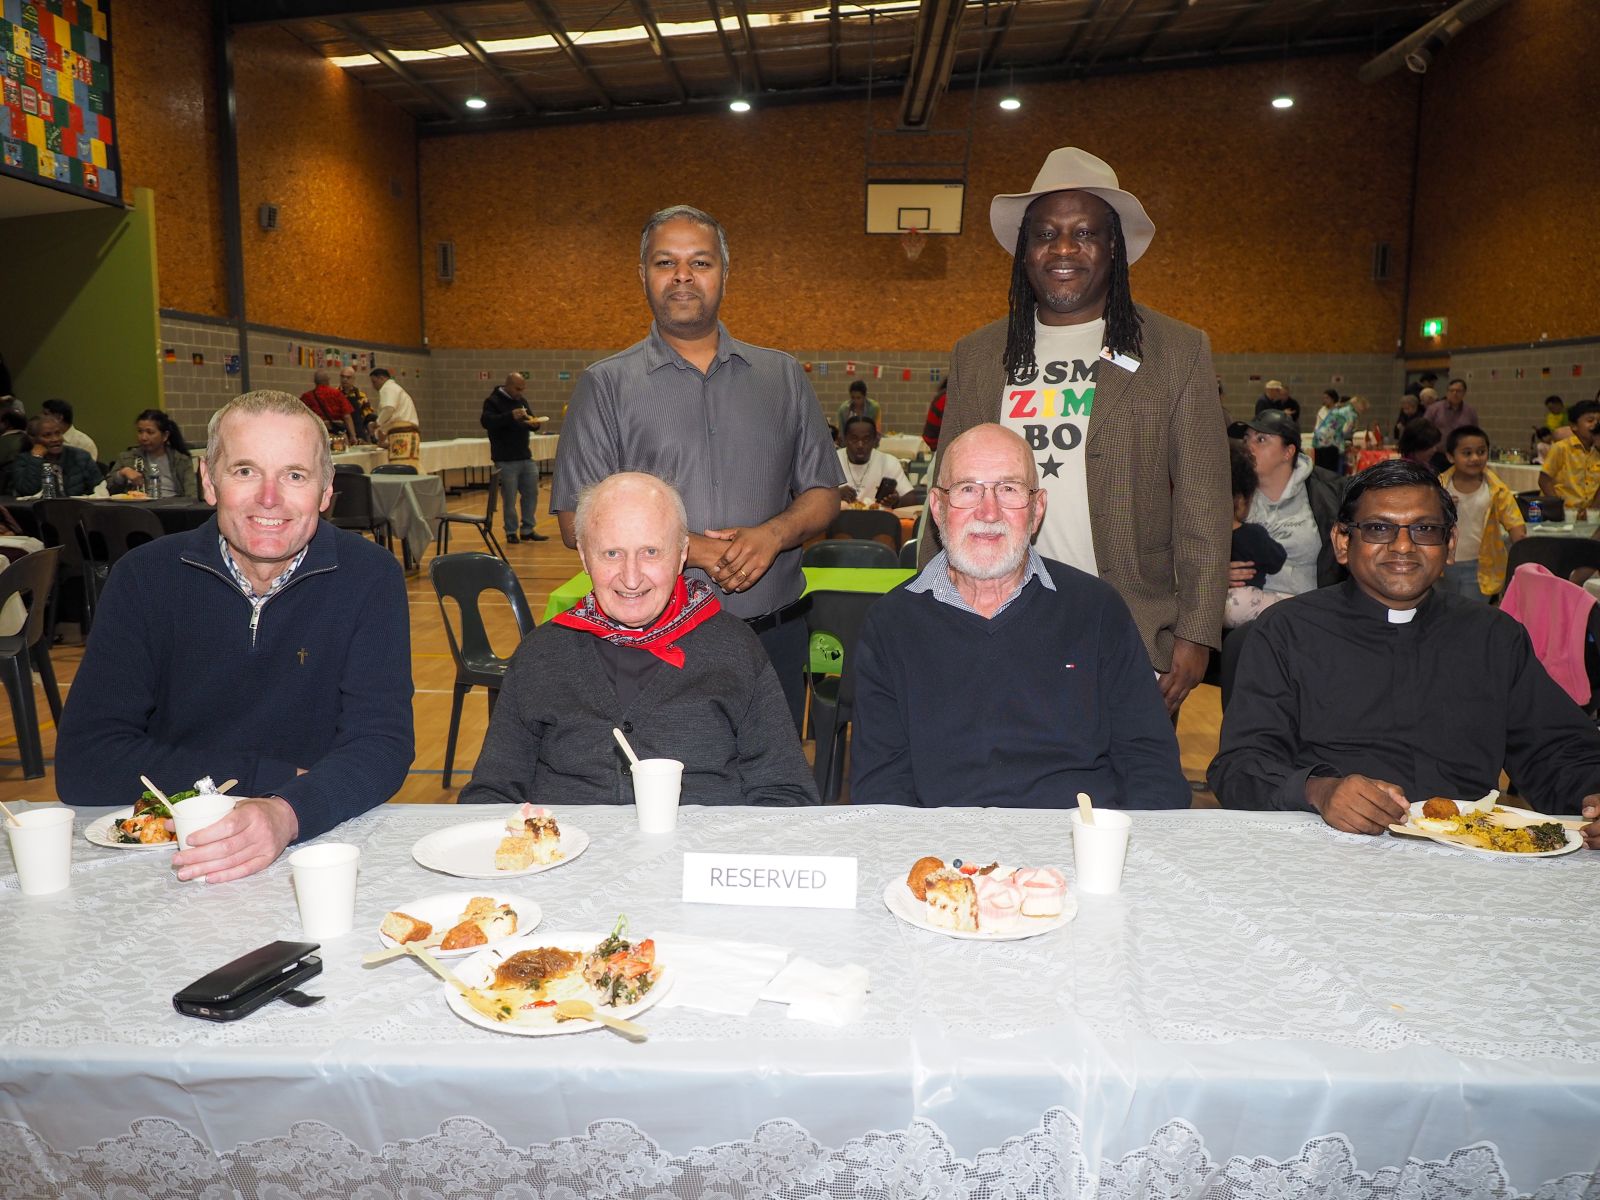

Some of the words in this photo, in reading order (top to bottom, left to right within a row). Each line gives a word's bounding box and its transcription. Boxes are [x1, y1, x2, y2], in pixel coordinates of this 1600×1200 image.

[1009, 388, 1096, 418] ZIM
[1023, 423, 1082, 450] BO
[710, 867, 827, 889] RESERVED
